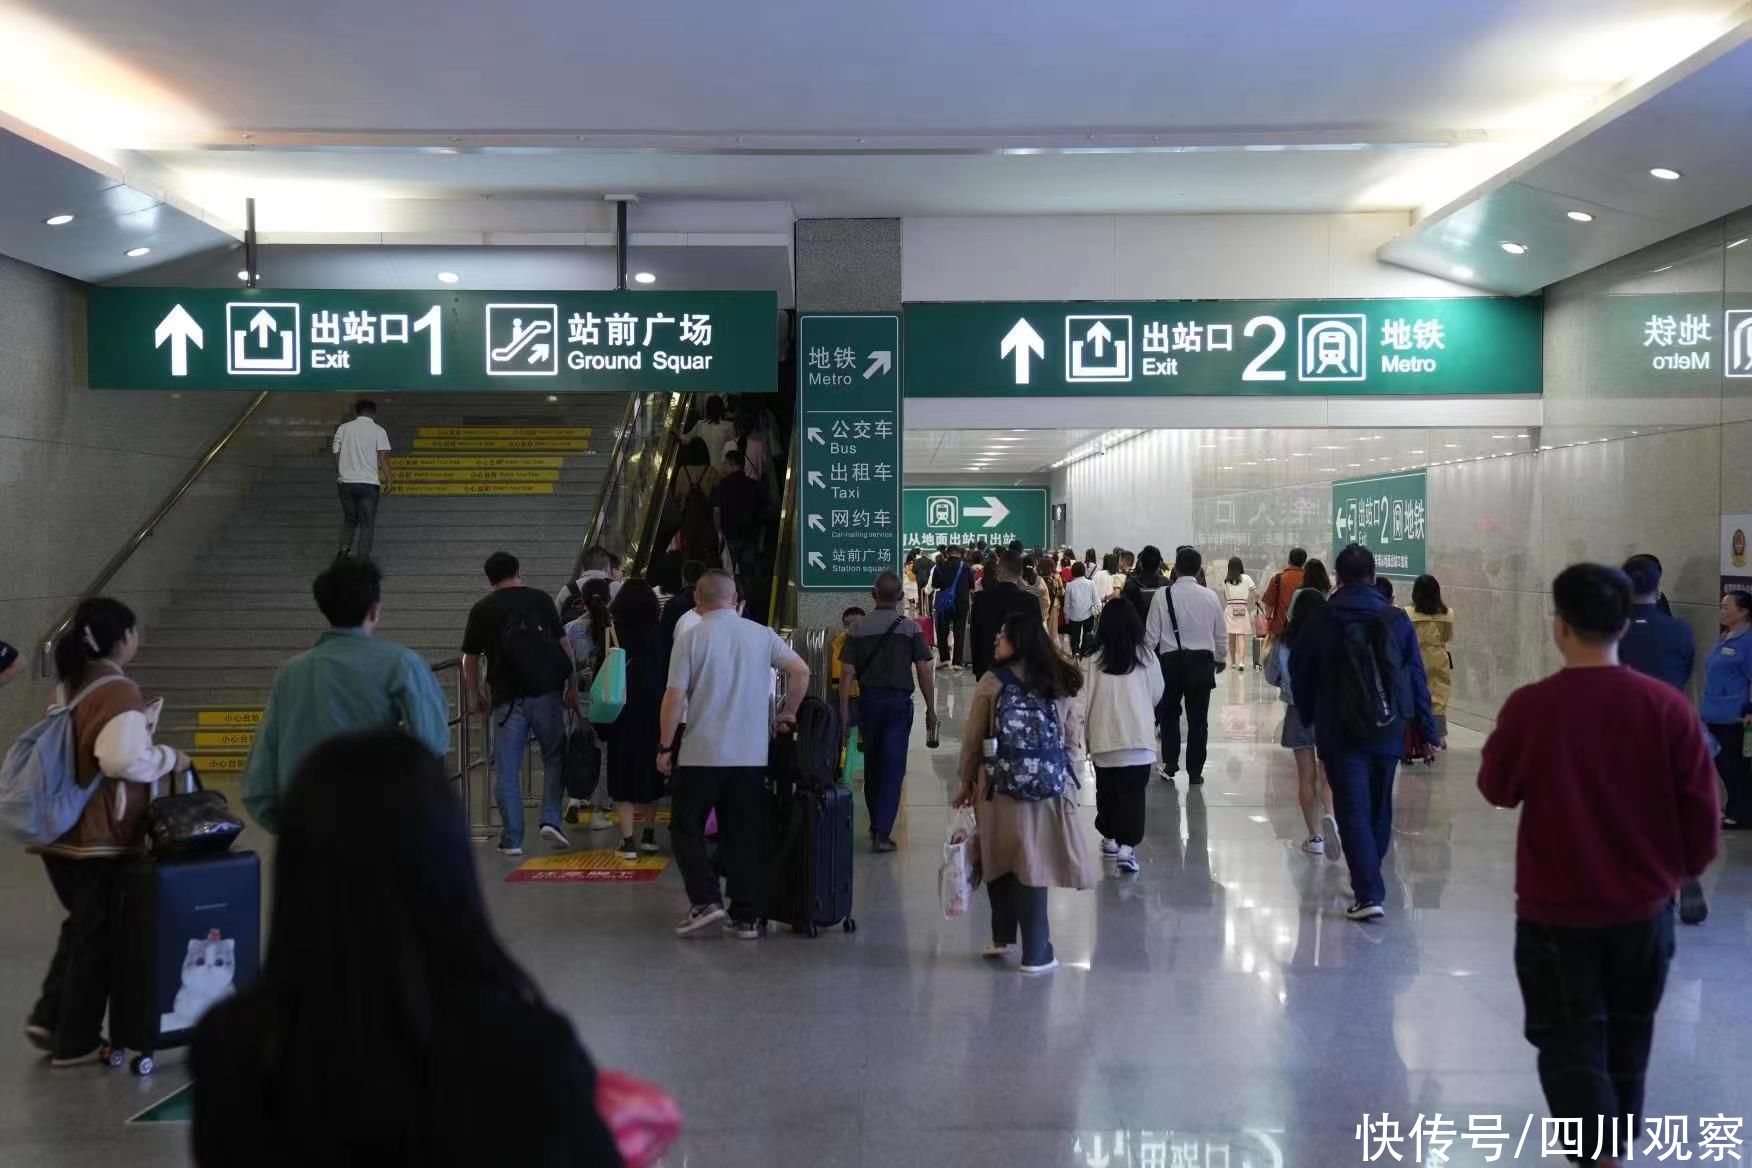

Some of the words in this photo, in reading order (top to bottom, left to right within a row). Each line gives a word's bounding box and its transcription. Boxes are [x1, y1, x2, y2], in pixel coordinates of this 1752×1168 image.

[567, 311, 713, 347] 站前广场
[1380, 317, 1446, 351] 地铁
[311, 311, 409, 345] 出站口
[413, 304, 442, 376] 1
[1142, 320, 1233, 354] 出站口
[1241, 315, 1287, 382] 2
[311, 349, 350, 369] Exit
[567, 350, 642, 371] Ground
[652, 350, 713, 372] Squar
[808, 346, 857, 370] 地铁
[1142, 357, 1178, 377] Exit
[1381, 354, 1437, 374] Metro
[808, 372, 853, 386] Metro
[831, 419, 893, 440] 公交车
[830, 442, 857, 455] Bus
[830, 462, 893, 482] 出租车
[830, 486, 861, 500] Taxi
[831, 508, 892, 529] 网约车
[1380, 495, 1389, 544] 2
[1404, 498, 1425, 540] 地铁
[832, 548, 891, 562] 站前广场
[832, 564, 861, 572] Station
